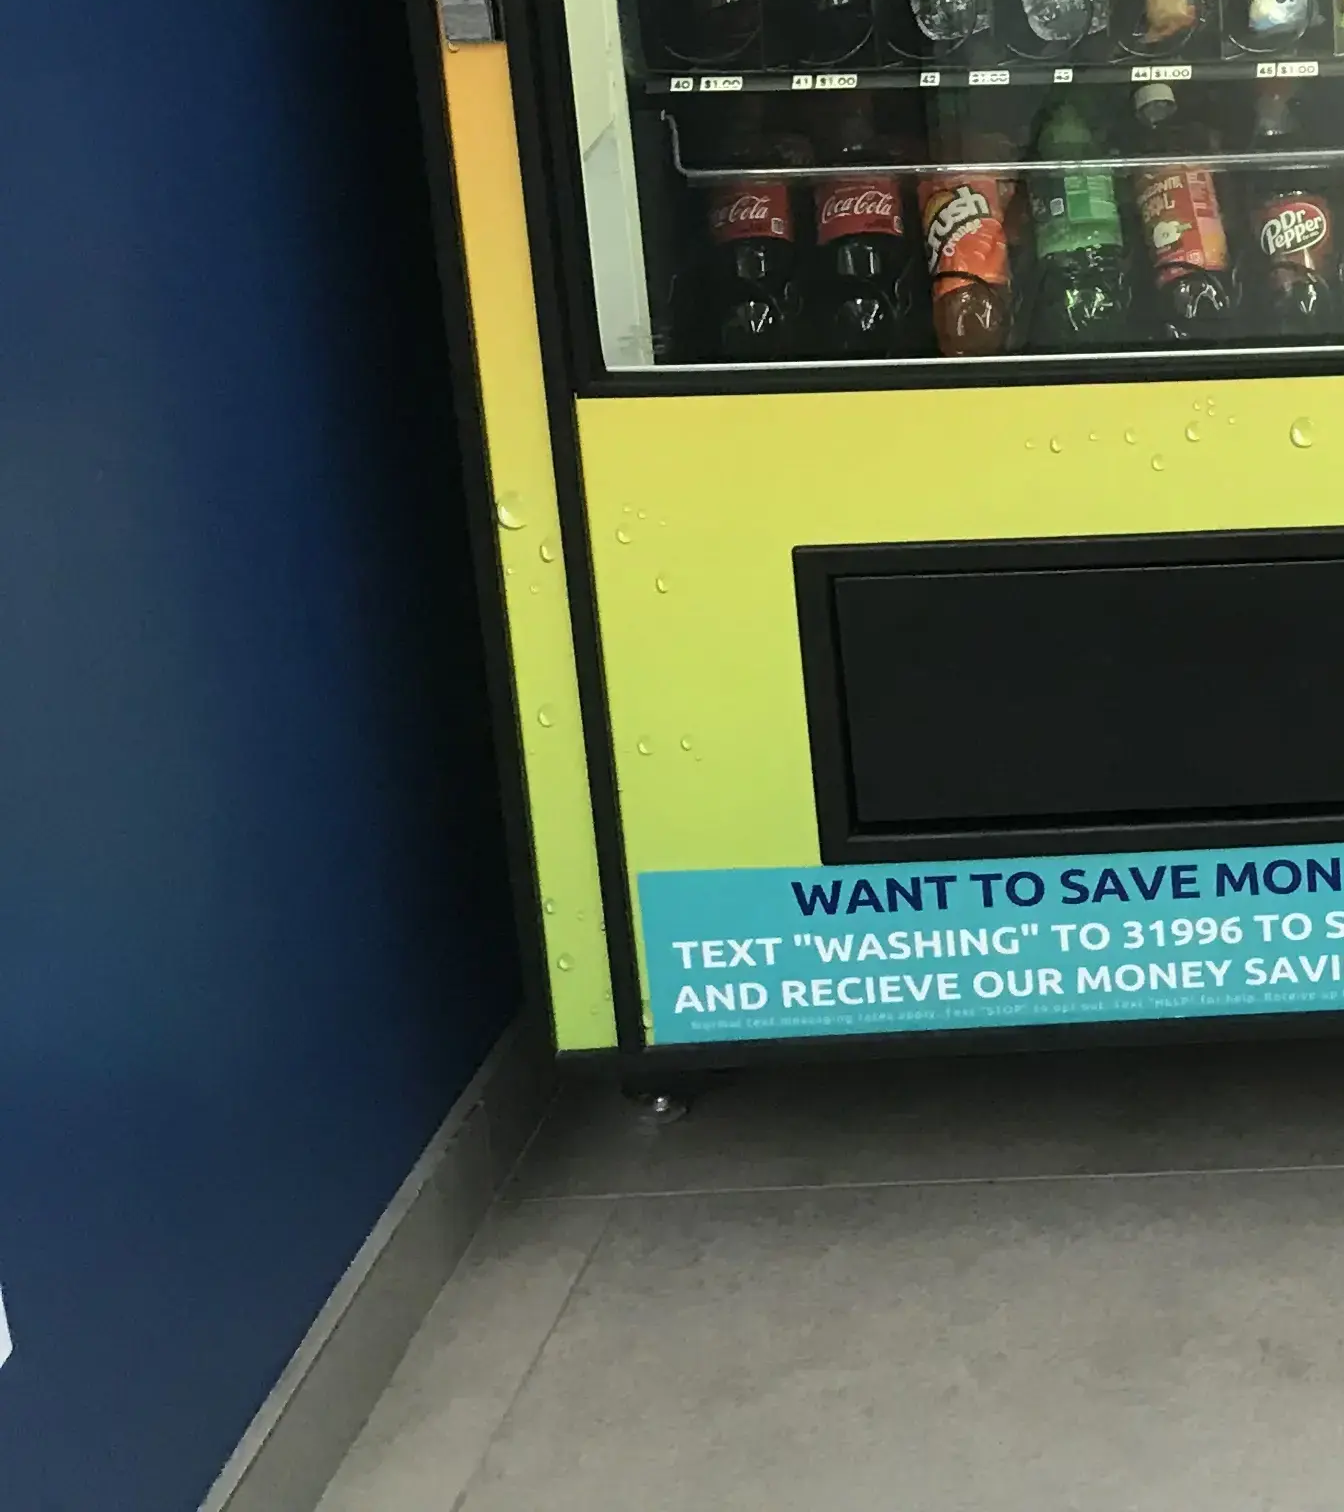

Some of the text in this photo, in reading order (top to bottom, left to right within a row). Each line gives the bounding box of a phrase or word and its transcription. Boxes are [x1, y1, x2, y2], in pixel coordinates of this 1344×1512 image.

[674, 79, 691, 89] 40
[818, 76, 856, 87] $1.00
[922, 74, 937, 84] 42
[1154, 68, 1190, 78] $1.00
[822, 190, 893, 225] Coca-Cola
[1279, 208, 1307, 230] Dr
[1265, 215, 1323, 255] Pepper
[790, 874, 958, 917] WANT
[969, 870, 1046, 908] TO
[1061, 863, 1201, 905] SAVE
[673, 936, 782, 969] TEXT
[794, 923, 1039, 963] "WASHING"
[1051, 922, 1111, 952] TO
[1122, 915, 1243, 950] 31996
[1254, 912, 1313, 942] TO
[673, 982, 767, 1015] AND
[781, 972, 961, 1010] RECIEVE
[972, 967, 1066, 999] OUR
[1077, 959, 1233, 995] MONEY
[777, 1013, 853, 1029] messaging
[1264, 990, 1316, 1003] Receive
[1320, 989, 1338, 1001] up
